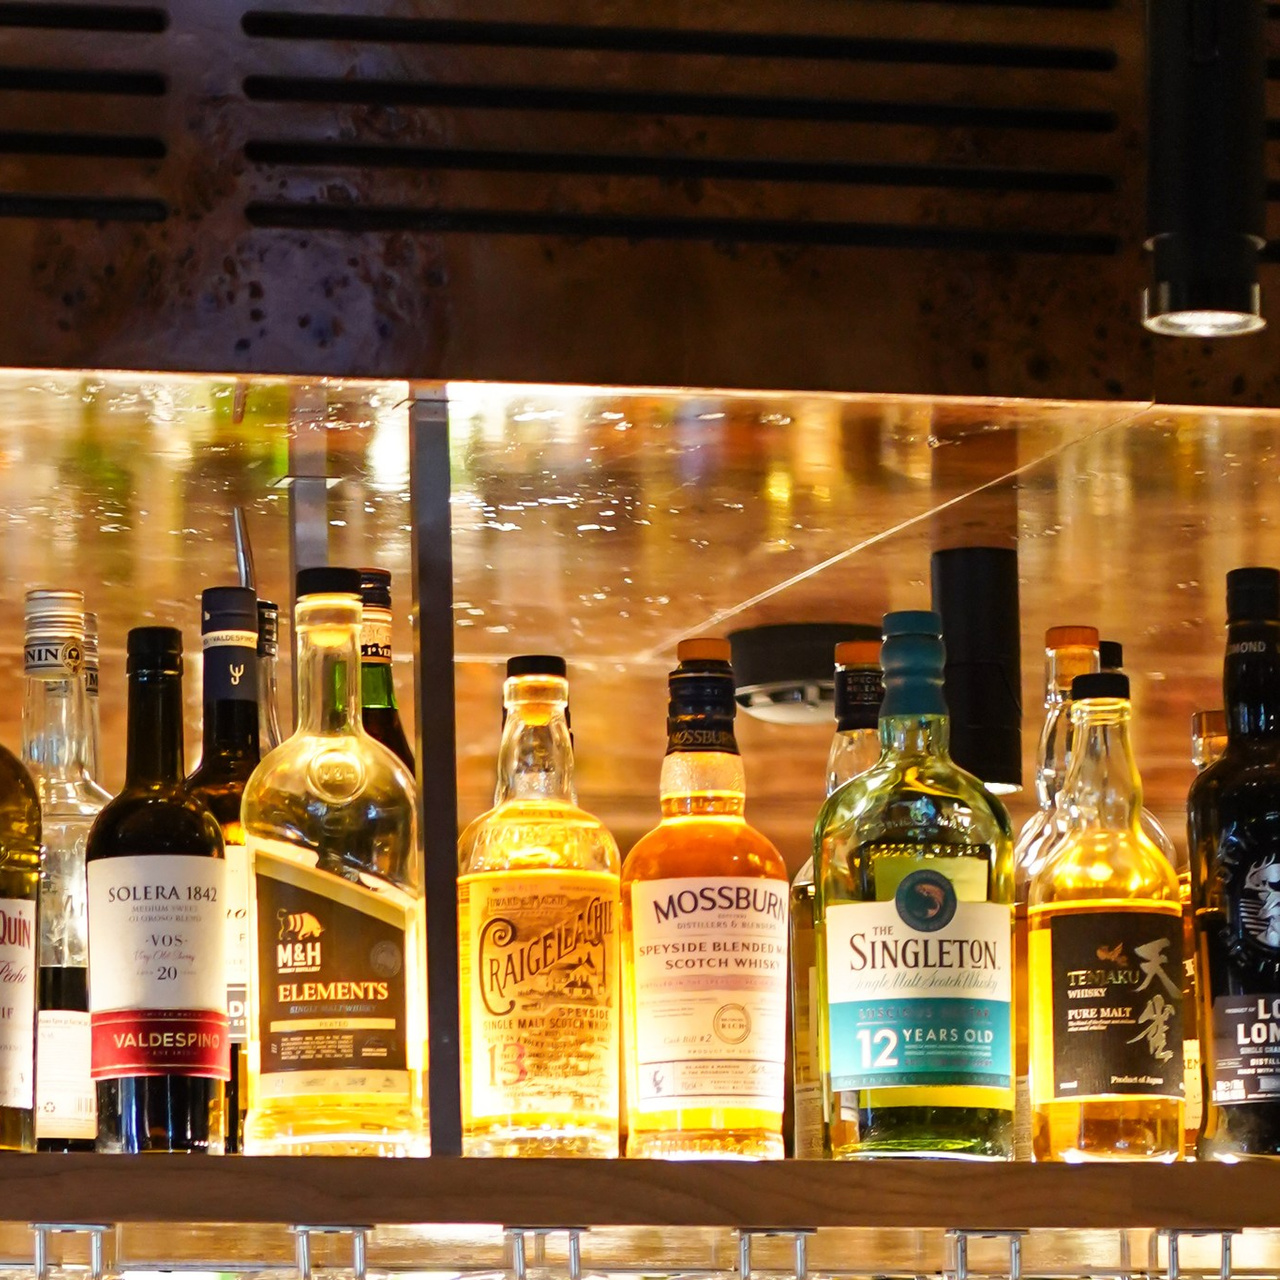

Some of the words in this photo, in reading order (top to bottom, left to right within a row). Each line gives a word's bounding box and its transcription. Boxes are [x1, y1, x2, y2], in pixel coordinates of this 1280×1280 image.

[108, 885, 180, 903] SOLERA
[187, 886, 217, 903] 1842
[653, 886, 788, 924] MOSSBURN
[677, 921, 728, 930] DISTILLERS
[872, 926, 894, 936] THE
[277, 942, 321, 969] M&H
[479, 896, 615, 1016] CRAIGELLACHIE
[639, 942, 707, 956] SPEYSIDE
[712, 941, 774, 953] BLENDED
[849, 933, 998, 971] SINGLETON
[665, 957, 729, 970] SCOTCH
[735, 957, 780, 970] WHISKY
[157, 966, 178, 981] 20
[1067, 969, 1141, 987] TENJAKU
[278, 981, 389, 1002] ELEMENTS
[1067, 988, 1108, 999] WHISKY
[558, 1007, 610, 1020] SPEYSIDE
[1067, 1008, 1098, 1020] PURE
[1100, 1007, 1133, 1019] MALT
[483, 1020, 514, 1031] SINGLE
[517, 1019, 545, 1031] MALT
[549, 1019, 585, 1030] SCOTCH
[113, 1032, 220, 1049] VALDESPINO
[856, 1028, 899, 1069] 12
[902, 1028, 959, 1043] YEARS
[964, 1028, 994, 1043] OLD
